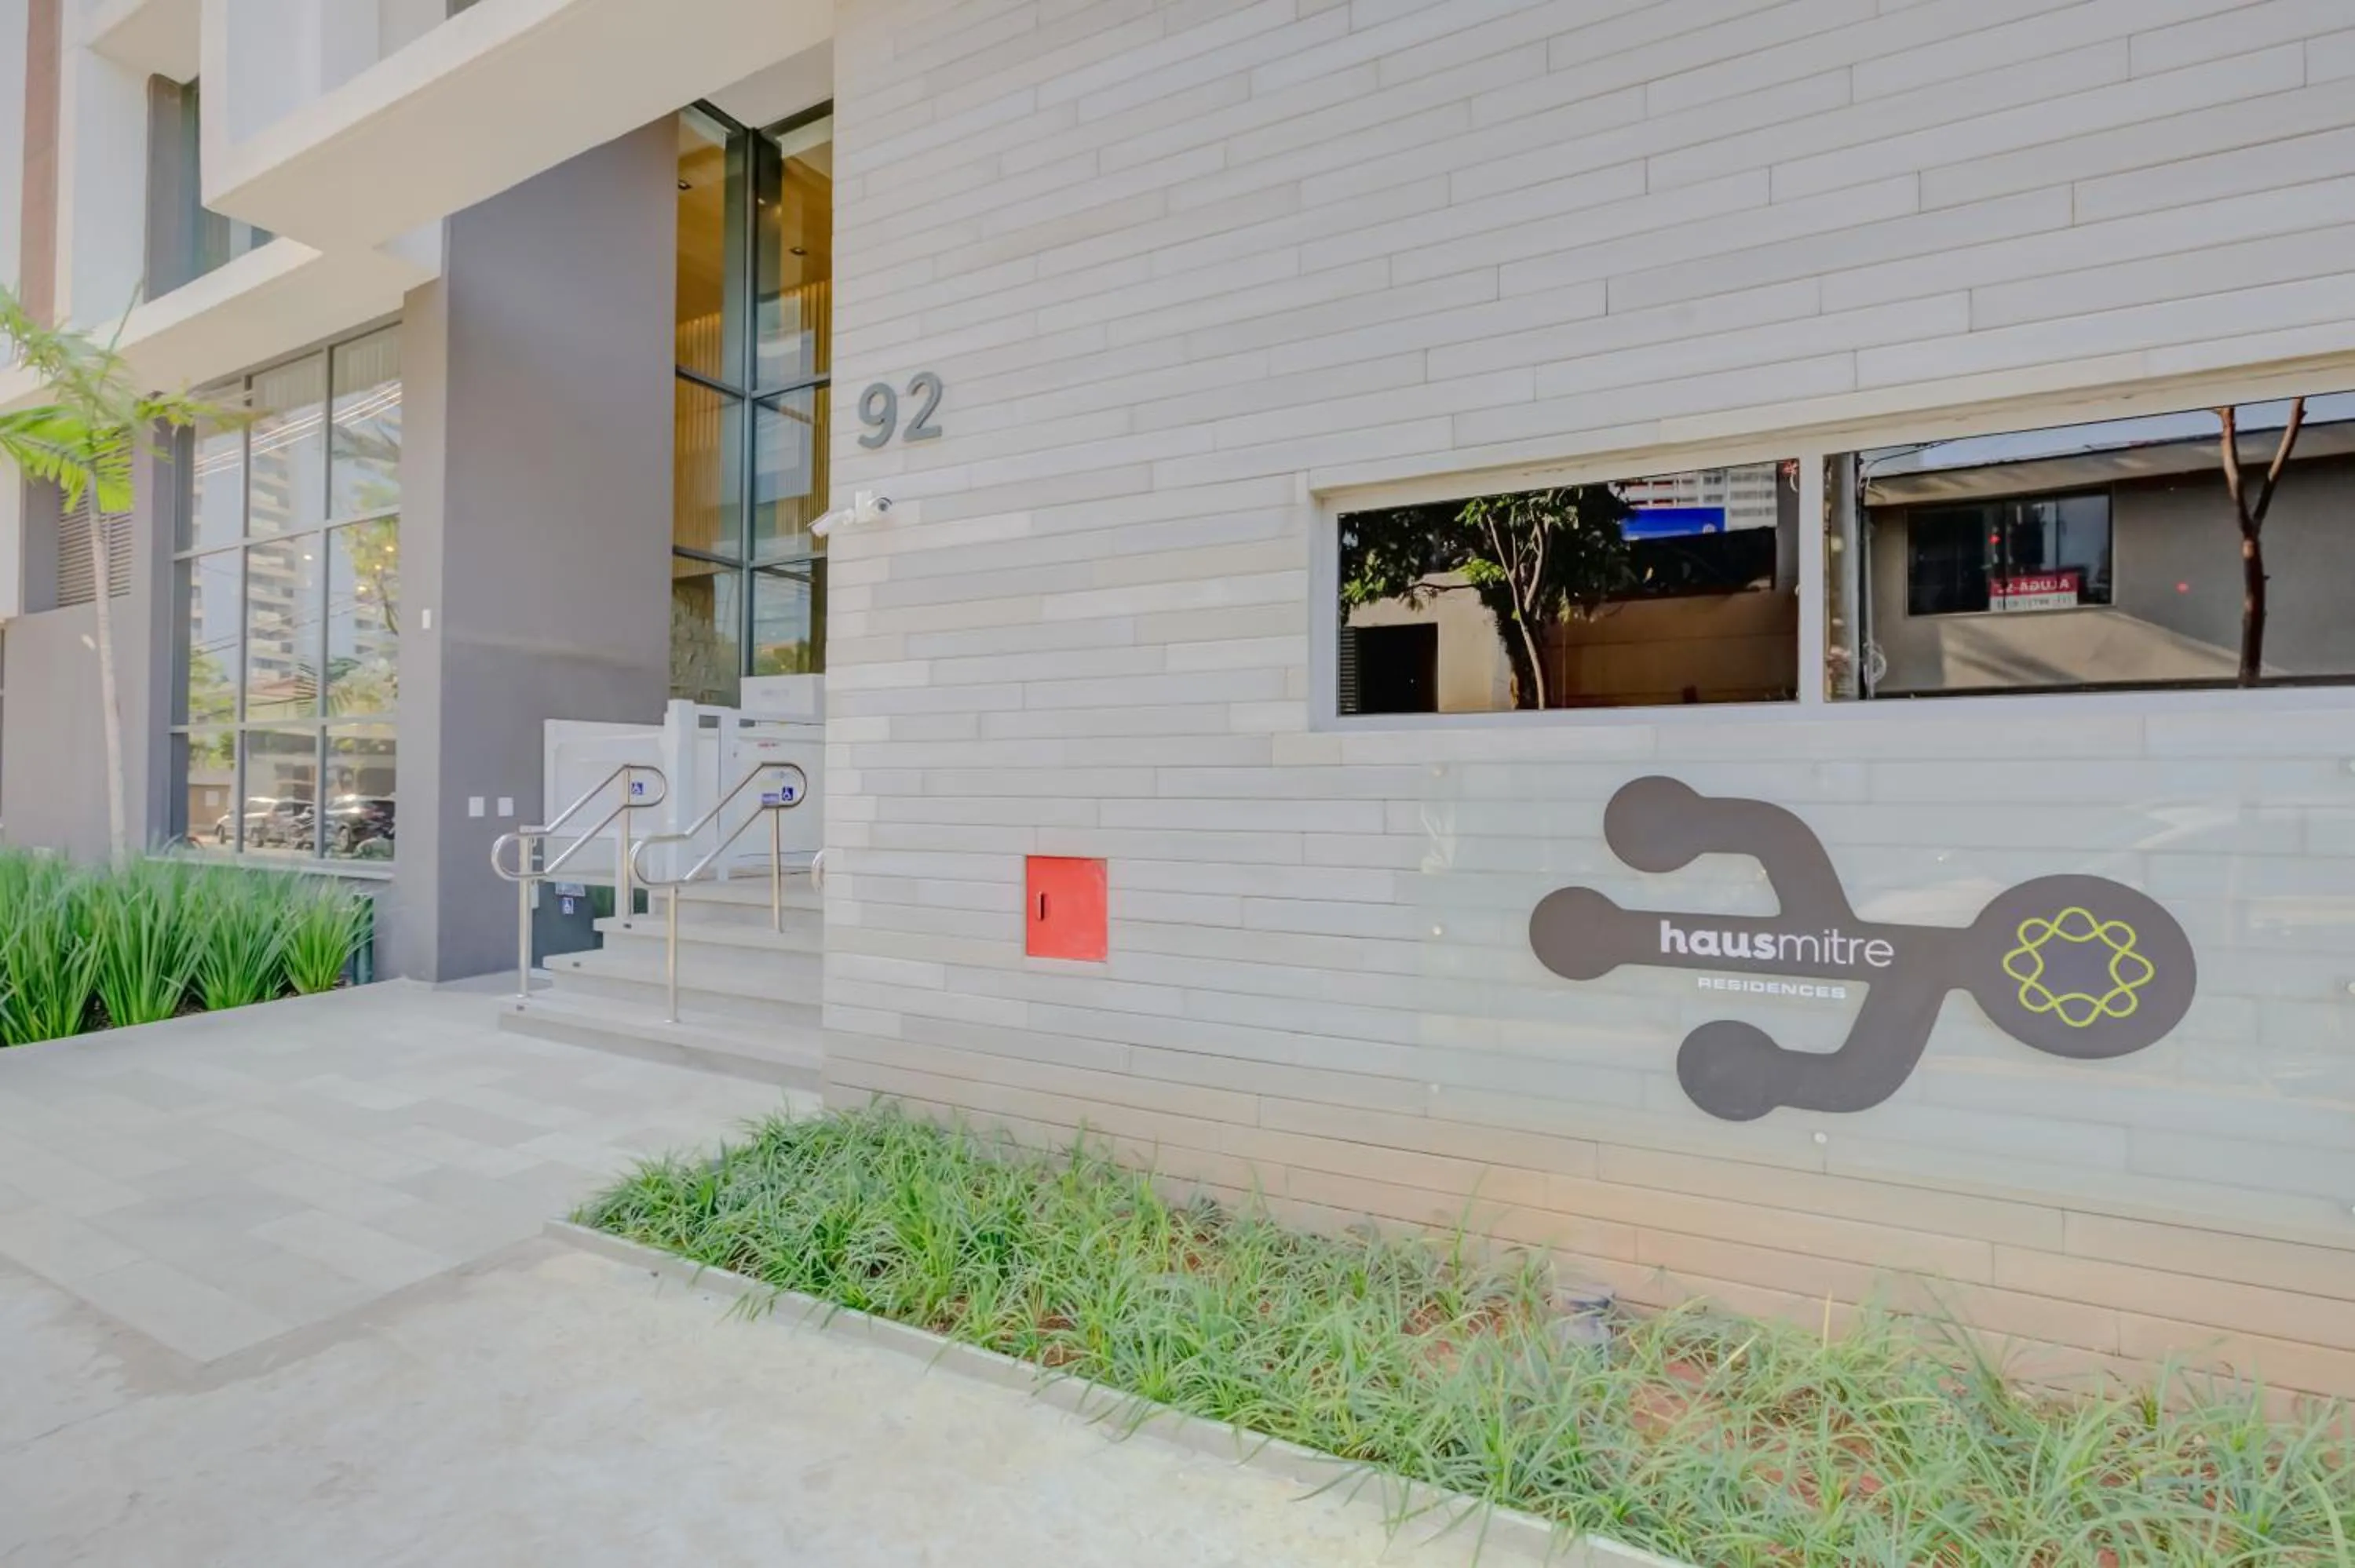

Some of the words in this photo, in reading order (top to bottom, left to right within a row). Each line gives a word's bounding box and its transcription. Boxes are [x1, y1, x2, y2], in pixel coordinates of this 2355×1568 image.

[857, 371, 943, 450] 92
[1659, 919, 1895, 968] hausmitre
[1697, 977, 1846, 999] RESIDENCES
